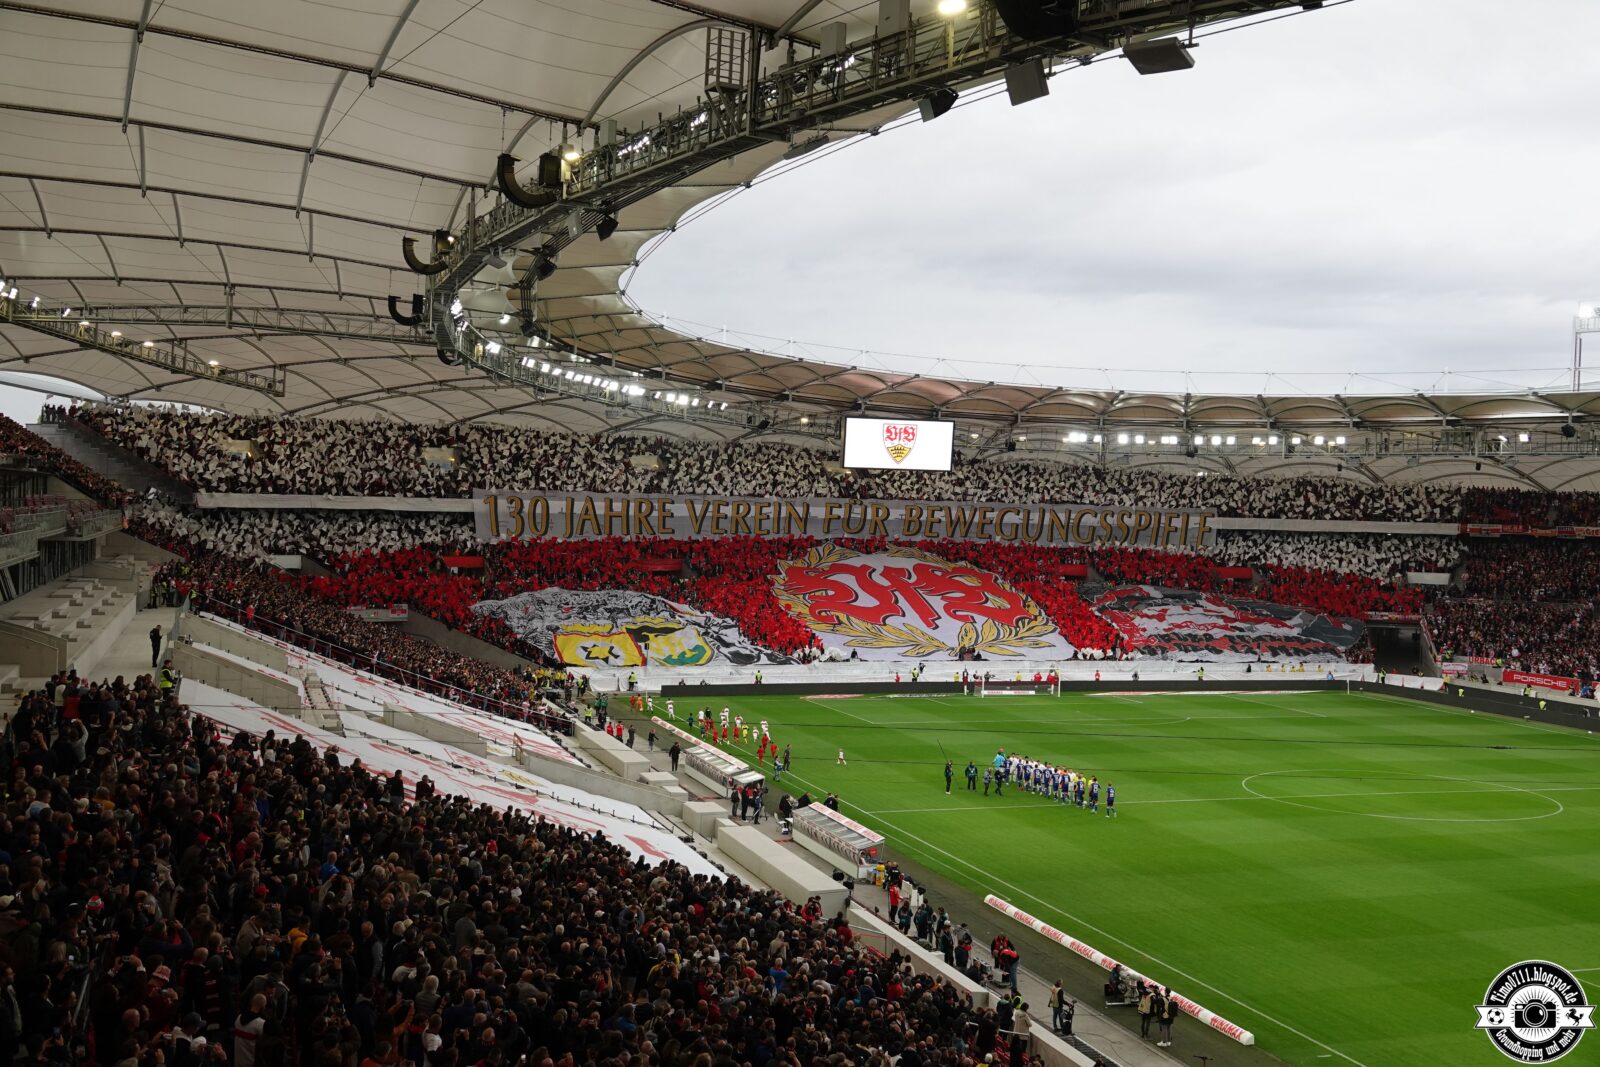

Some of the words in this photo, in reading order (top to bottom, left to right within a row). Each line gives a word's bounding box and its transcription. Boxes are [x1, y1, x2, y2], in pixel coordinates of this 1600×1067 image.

[885, 424, 916, 443] VfB
[484, 495, 549, 537] 130
[564, 496, 676, 536] JAHRE
[684, 500, 810, 536] VEREIN
[821, 500, 890, 537] FÜR
[1513, 674, 1568, 688] PORSCHE
[1210, 1015, 1243, 1042] WINAMAX
